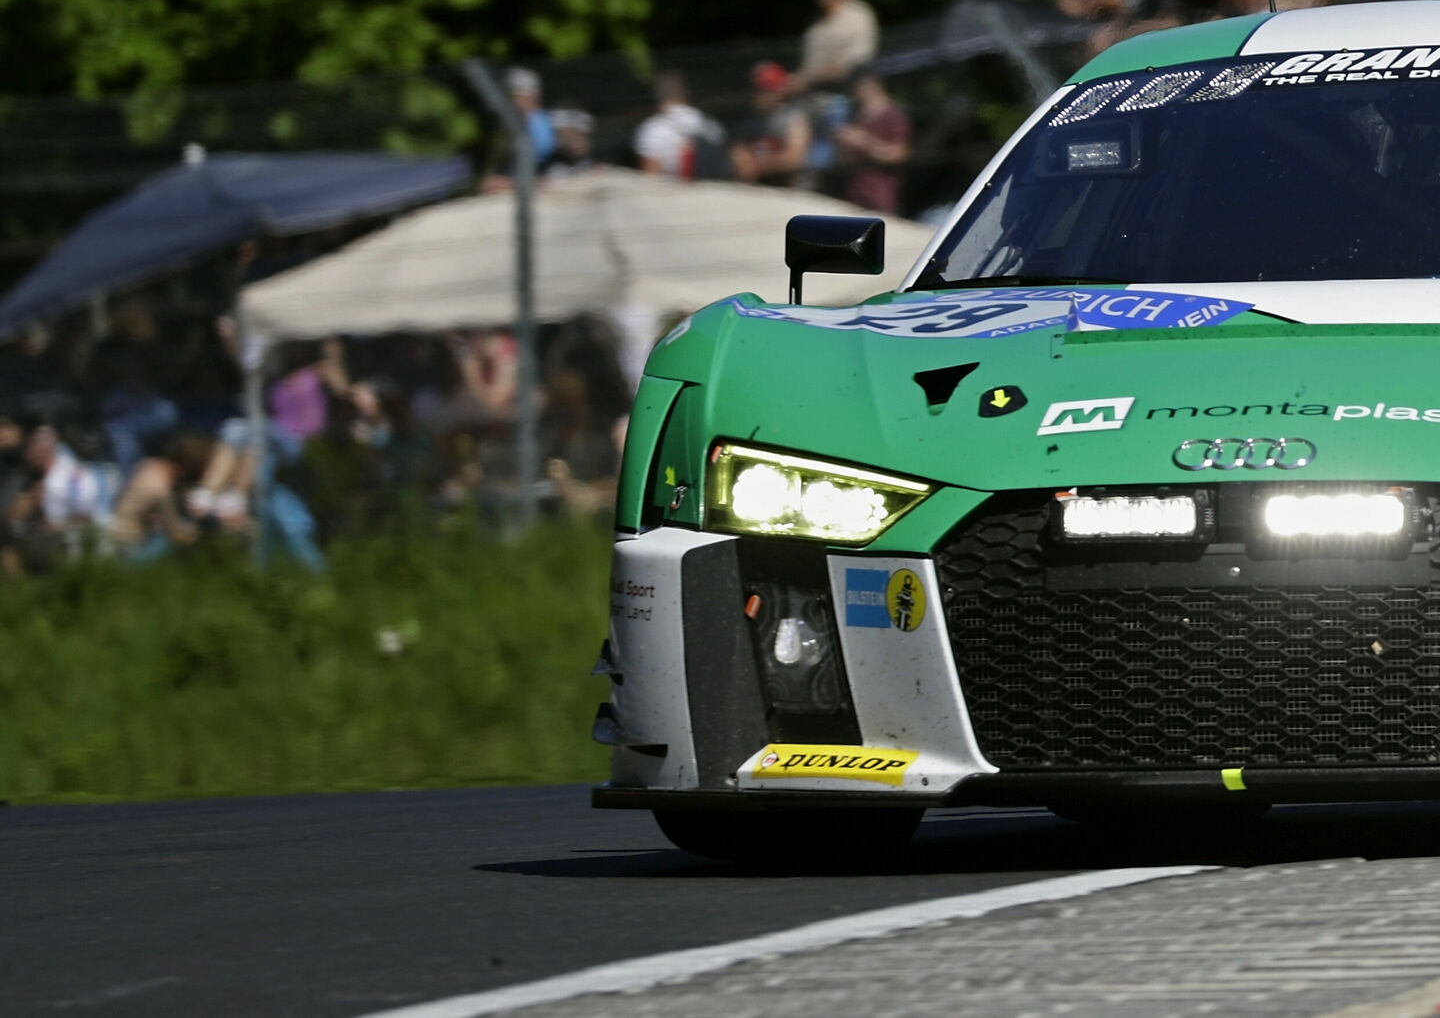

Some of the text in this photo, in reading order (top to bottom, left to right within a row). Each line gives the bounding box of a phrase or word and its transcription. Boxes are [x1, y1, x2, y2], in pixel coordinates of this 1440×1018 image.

[1262, 75, 1316, 86] THE
[1325, 70, 1382, 83] REAL
[989, 289, 1174, 322] ZURICH
[990, 317, 1064, 338] ADAC
[780, 753, 907, 772] DUNLOP
